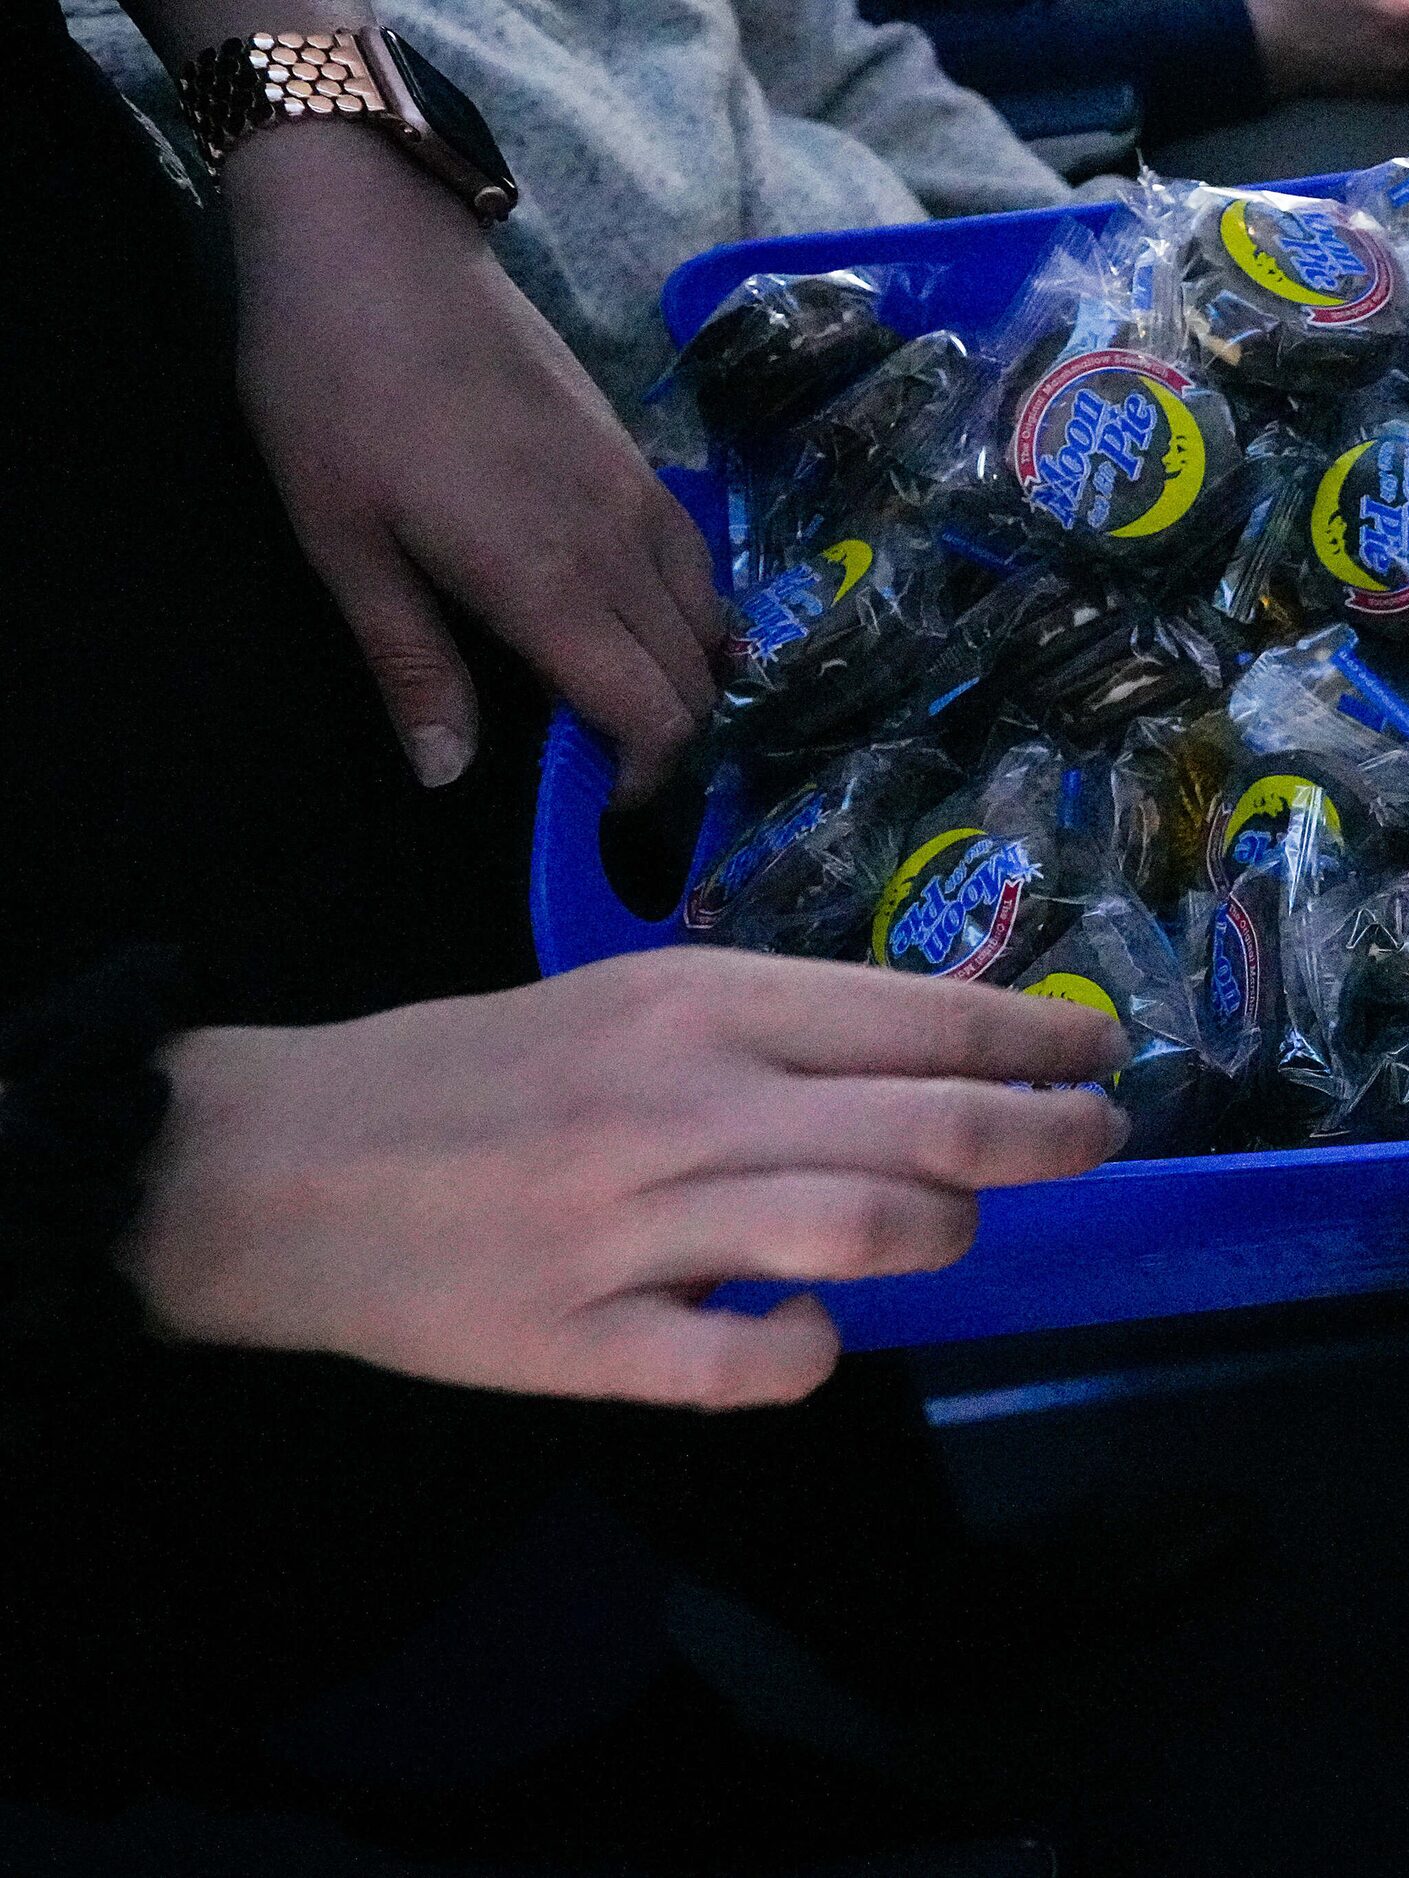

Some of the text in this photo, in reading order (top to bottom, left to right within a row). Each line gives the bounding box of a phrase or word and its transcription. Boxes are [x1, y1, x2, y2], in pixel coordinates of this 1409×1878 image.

[1028, 388, 1107, 531] Moon
[1097, 393, 1158, 481] Pie
[1359, 494, 1402, 576] Pie
[890, 875, 947, 959] Pie
[919, 842, 1027, 964] Moon
